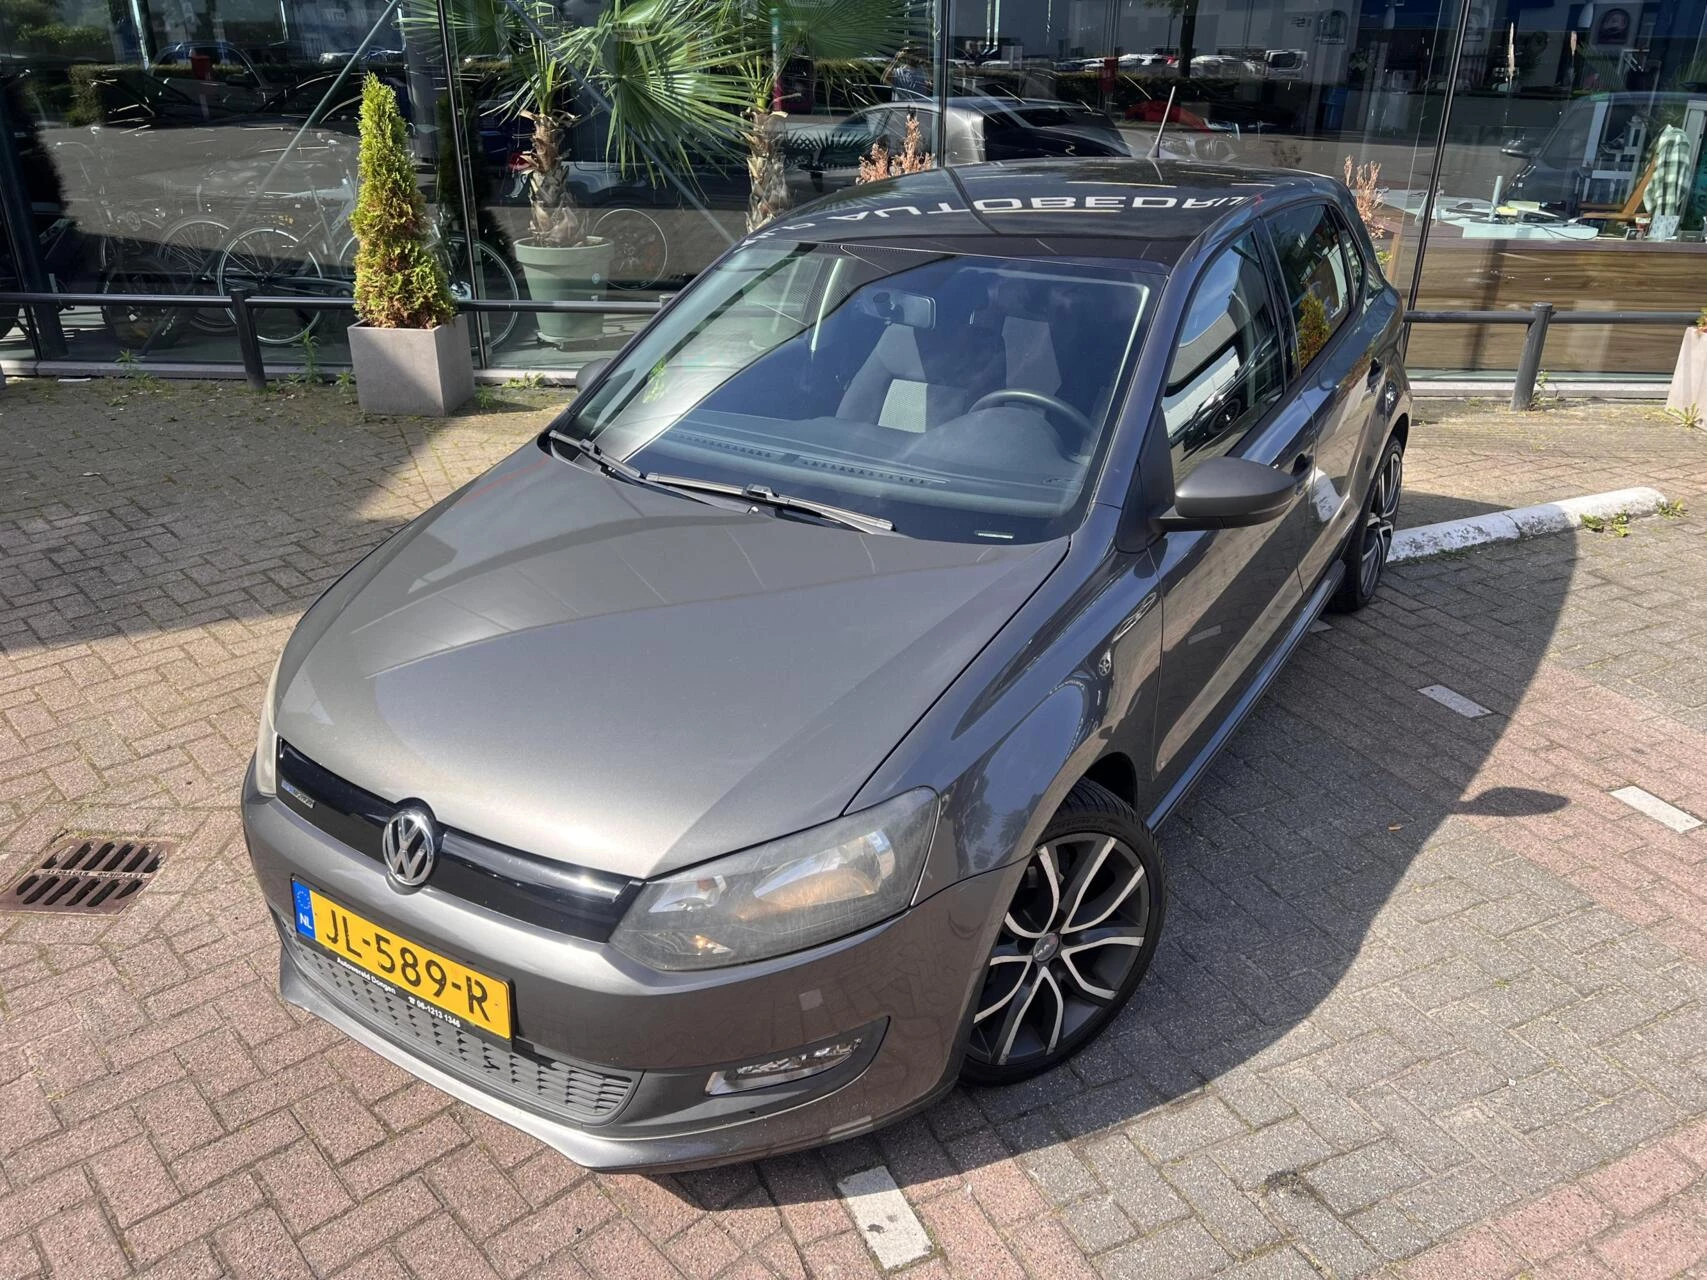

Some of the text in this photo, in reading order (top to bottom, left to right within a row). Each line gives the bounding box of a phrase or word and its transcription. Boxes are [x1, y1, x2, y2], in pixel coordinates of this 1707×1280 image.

[299, 913, 312, 930] NL
[326, 909, 490, 1022] JL-589-R
[371, 975, 396, 994] Dongen
